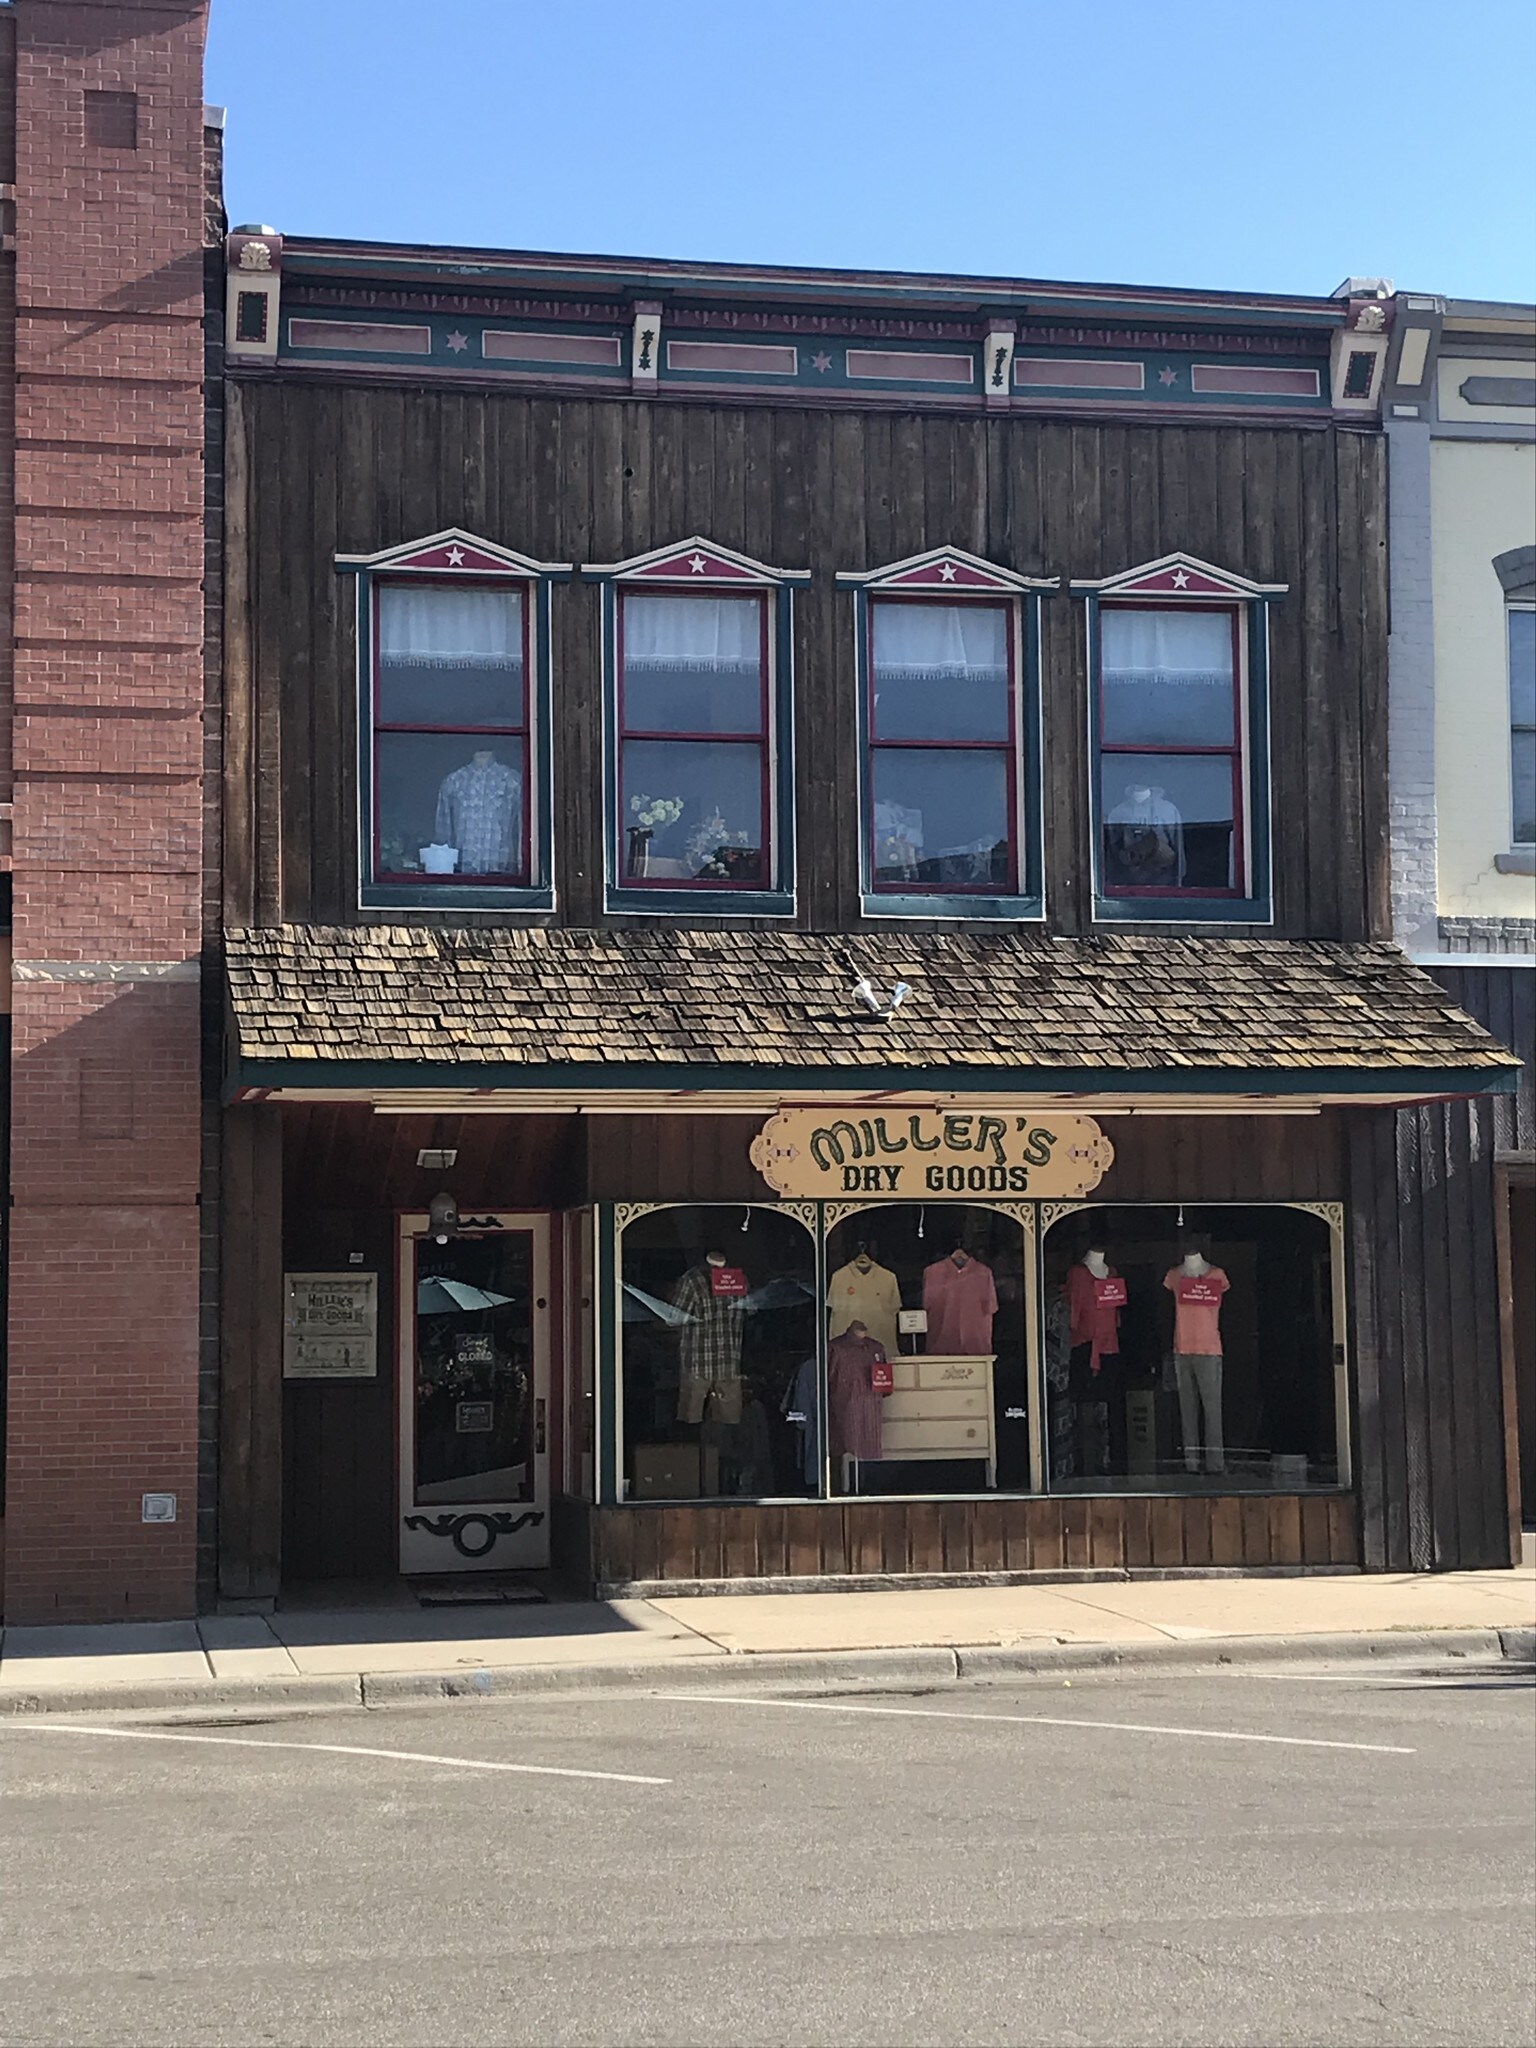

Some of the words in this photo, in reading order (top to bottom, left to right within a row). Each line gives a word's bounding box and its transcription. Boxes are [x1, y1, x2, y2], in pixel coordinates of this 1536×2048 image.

[810, 1115, 1057, 1171] MILLER'S
[841, 1165, 904, 1191] DRY
[925, 1166, 1029, 1191] GOODS
